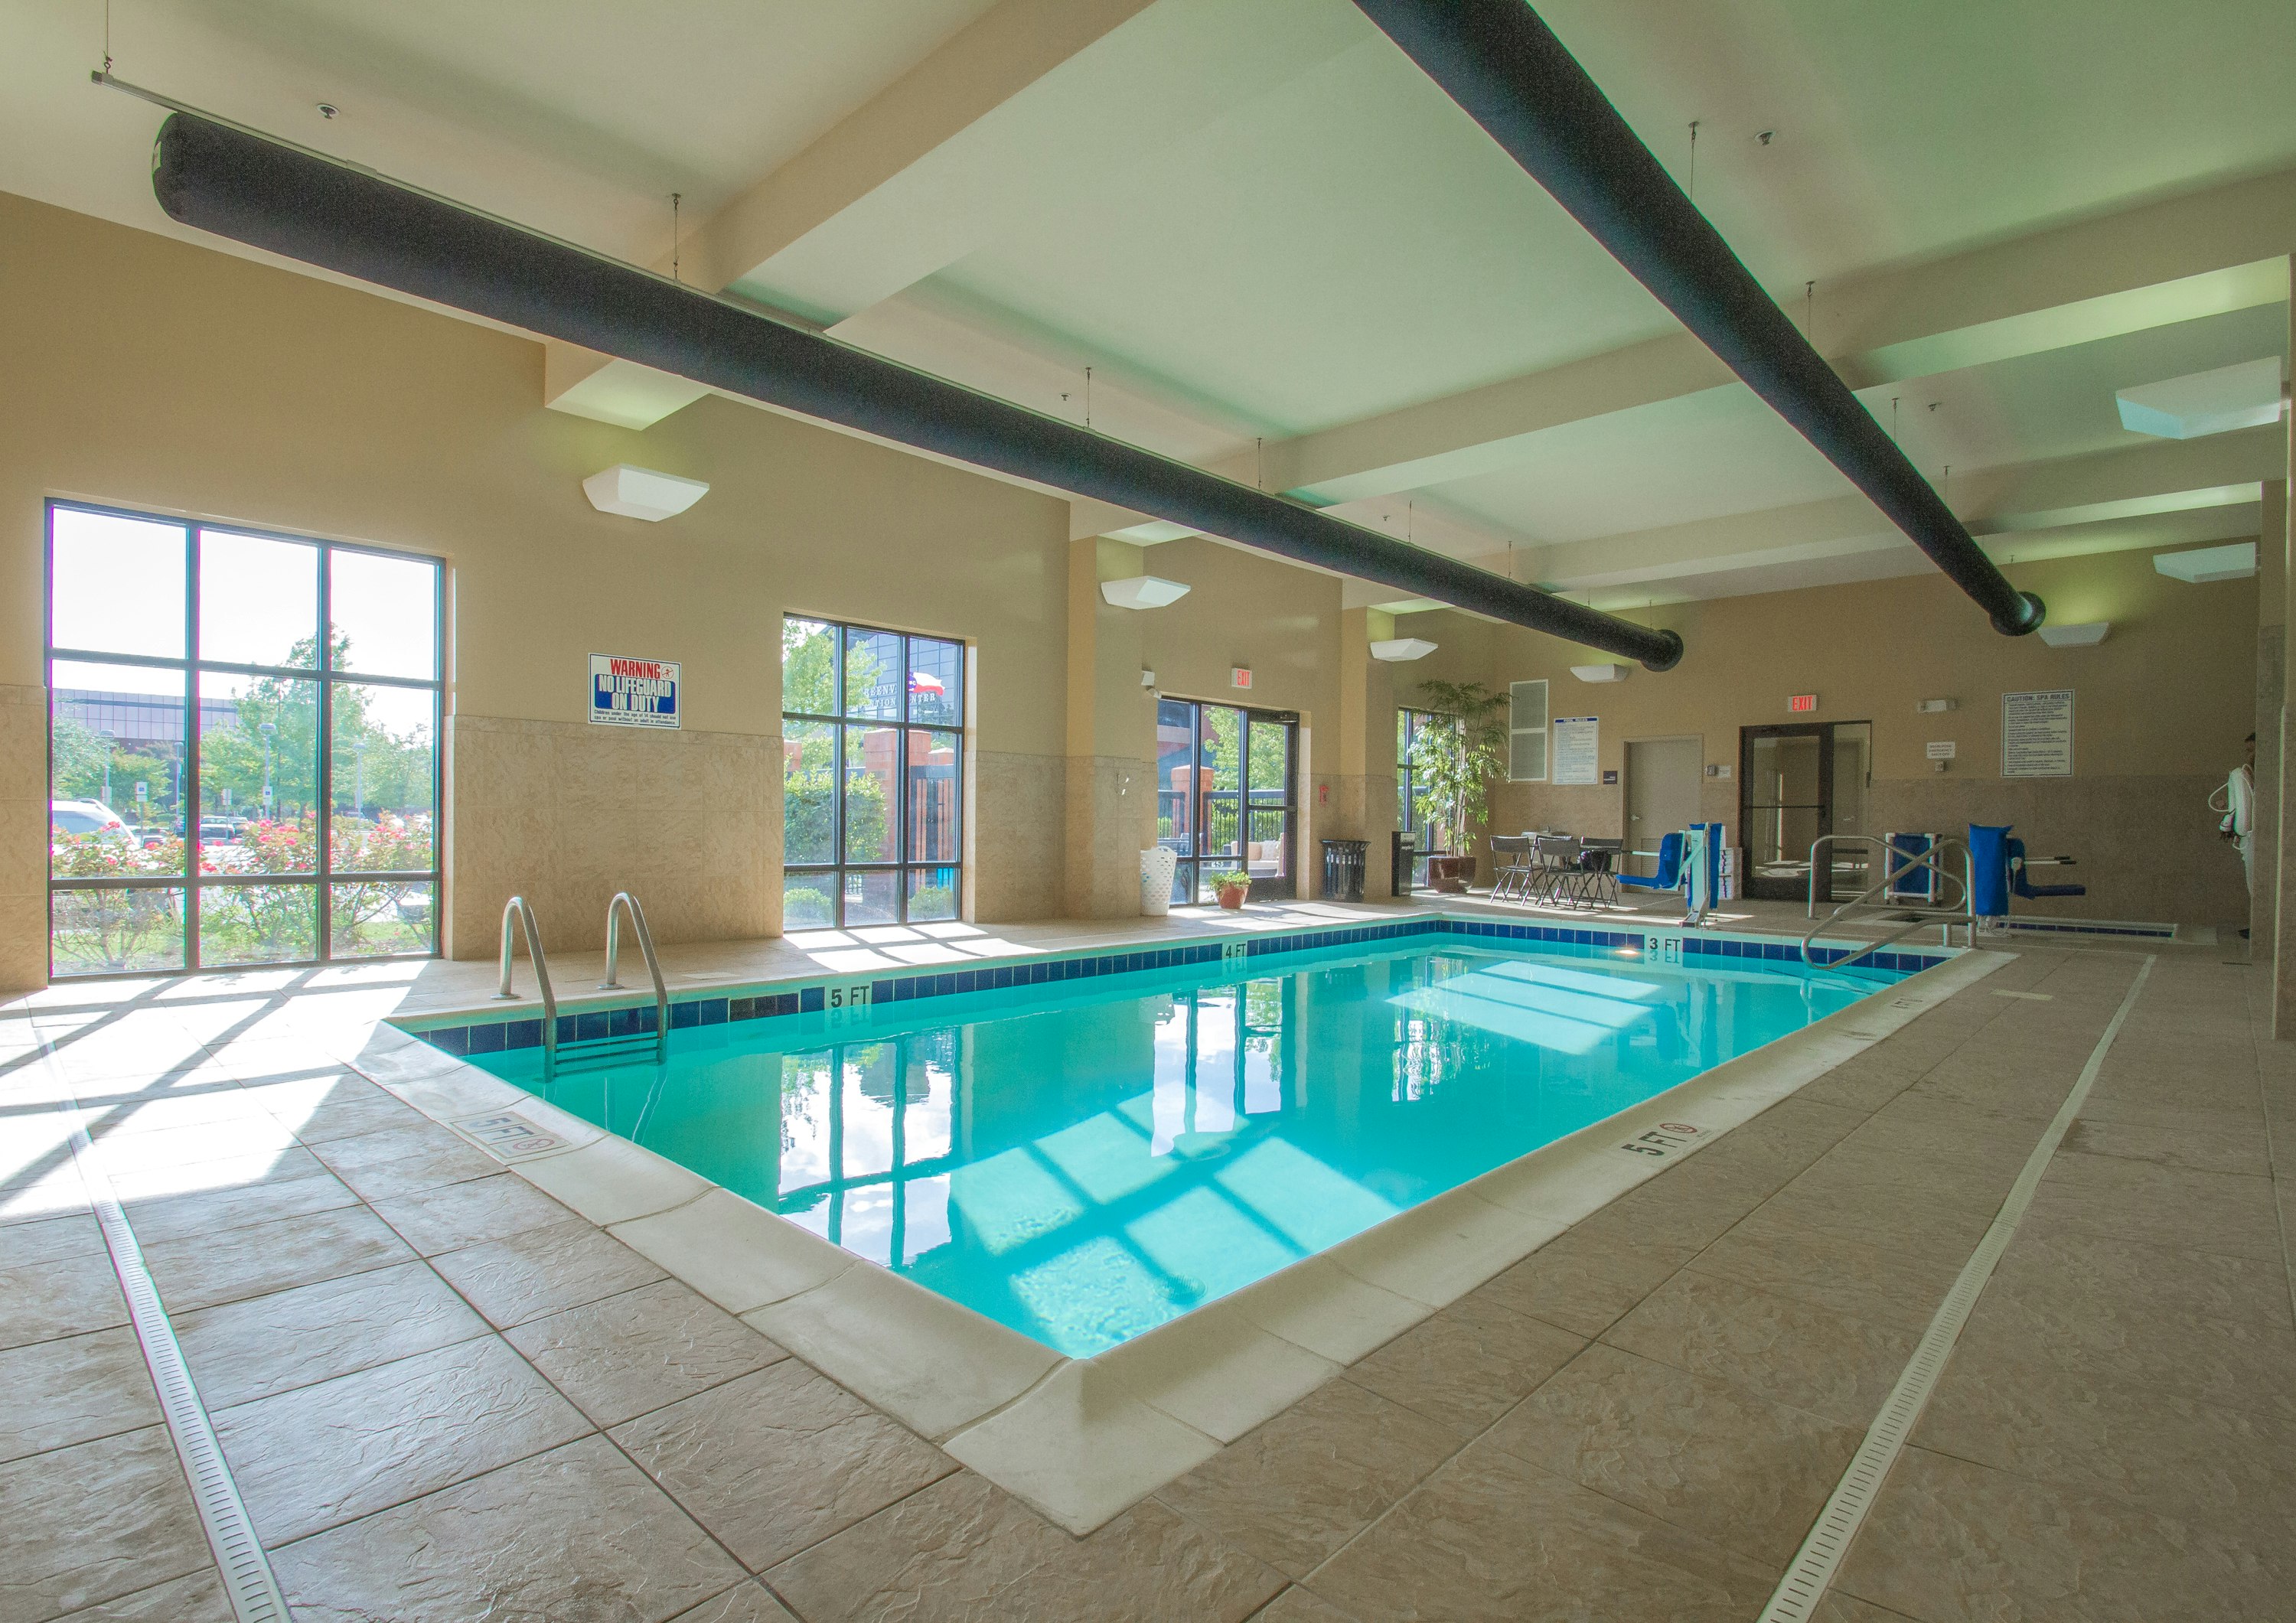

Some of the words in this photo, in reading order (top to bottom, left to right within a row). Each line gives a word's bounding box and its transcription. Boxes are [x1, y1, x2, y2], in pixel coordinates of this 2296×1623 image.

[610, 659, 660, 679] WARNING
[598, 674, 615, 693] NO
[616, 676, 672, 697] LIFEGUARD
[1237, 670, 1250, 686] EXIT
[612, 693, 628, 710] ON
[631, 695, 660, 712] DUTY
[1792, 696, 1813, 711] EXIT
[1226, 945, 1231, 959] 4
[1236, 943, 1246, 957] FT
[1649, 937, 1658, 950] 3
[1665, 938, 1681, 951] FT
[831, 989, 842, 1008] 5
[850, 986, 869, 1005] FT
[468, 1117, 512, 1127] 5
[480, 1126, 535, 1140] FT
[1638, 1131, 1688, 1148] FT
[1621, 1143, 1665, 1156] 5
